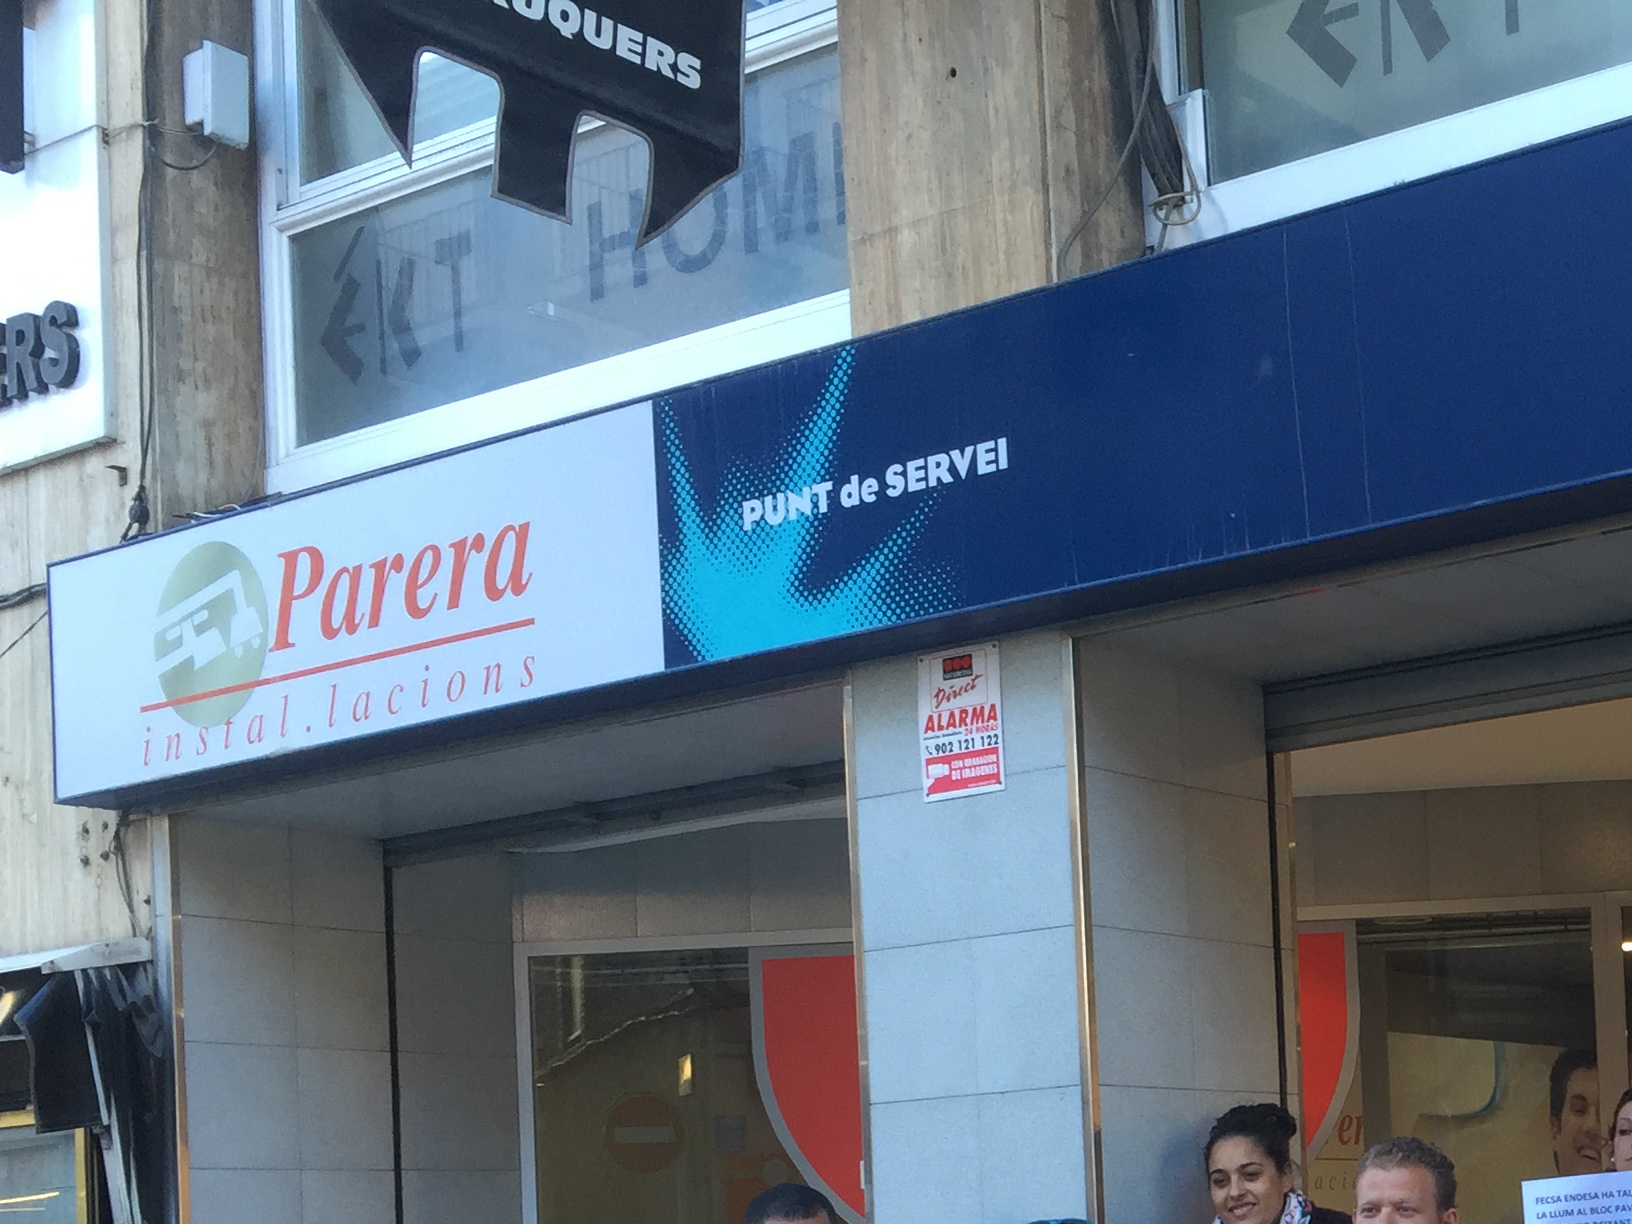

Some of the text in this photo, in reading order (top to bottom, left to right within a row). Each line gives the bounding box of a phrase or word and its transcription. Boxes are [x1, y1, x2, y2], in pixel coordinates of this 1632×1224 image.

[494, 0, 702, 90] UQUERS
[0, 299, 81, 408] RS
[742, 437, 1008, 531] PUNT de SERVEI
[269, 520, 533, 653] Parera
[924, 704, 998, 735] ALARMA
[935, 734, 999, 755] 902 121 122
